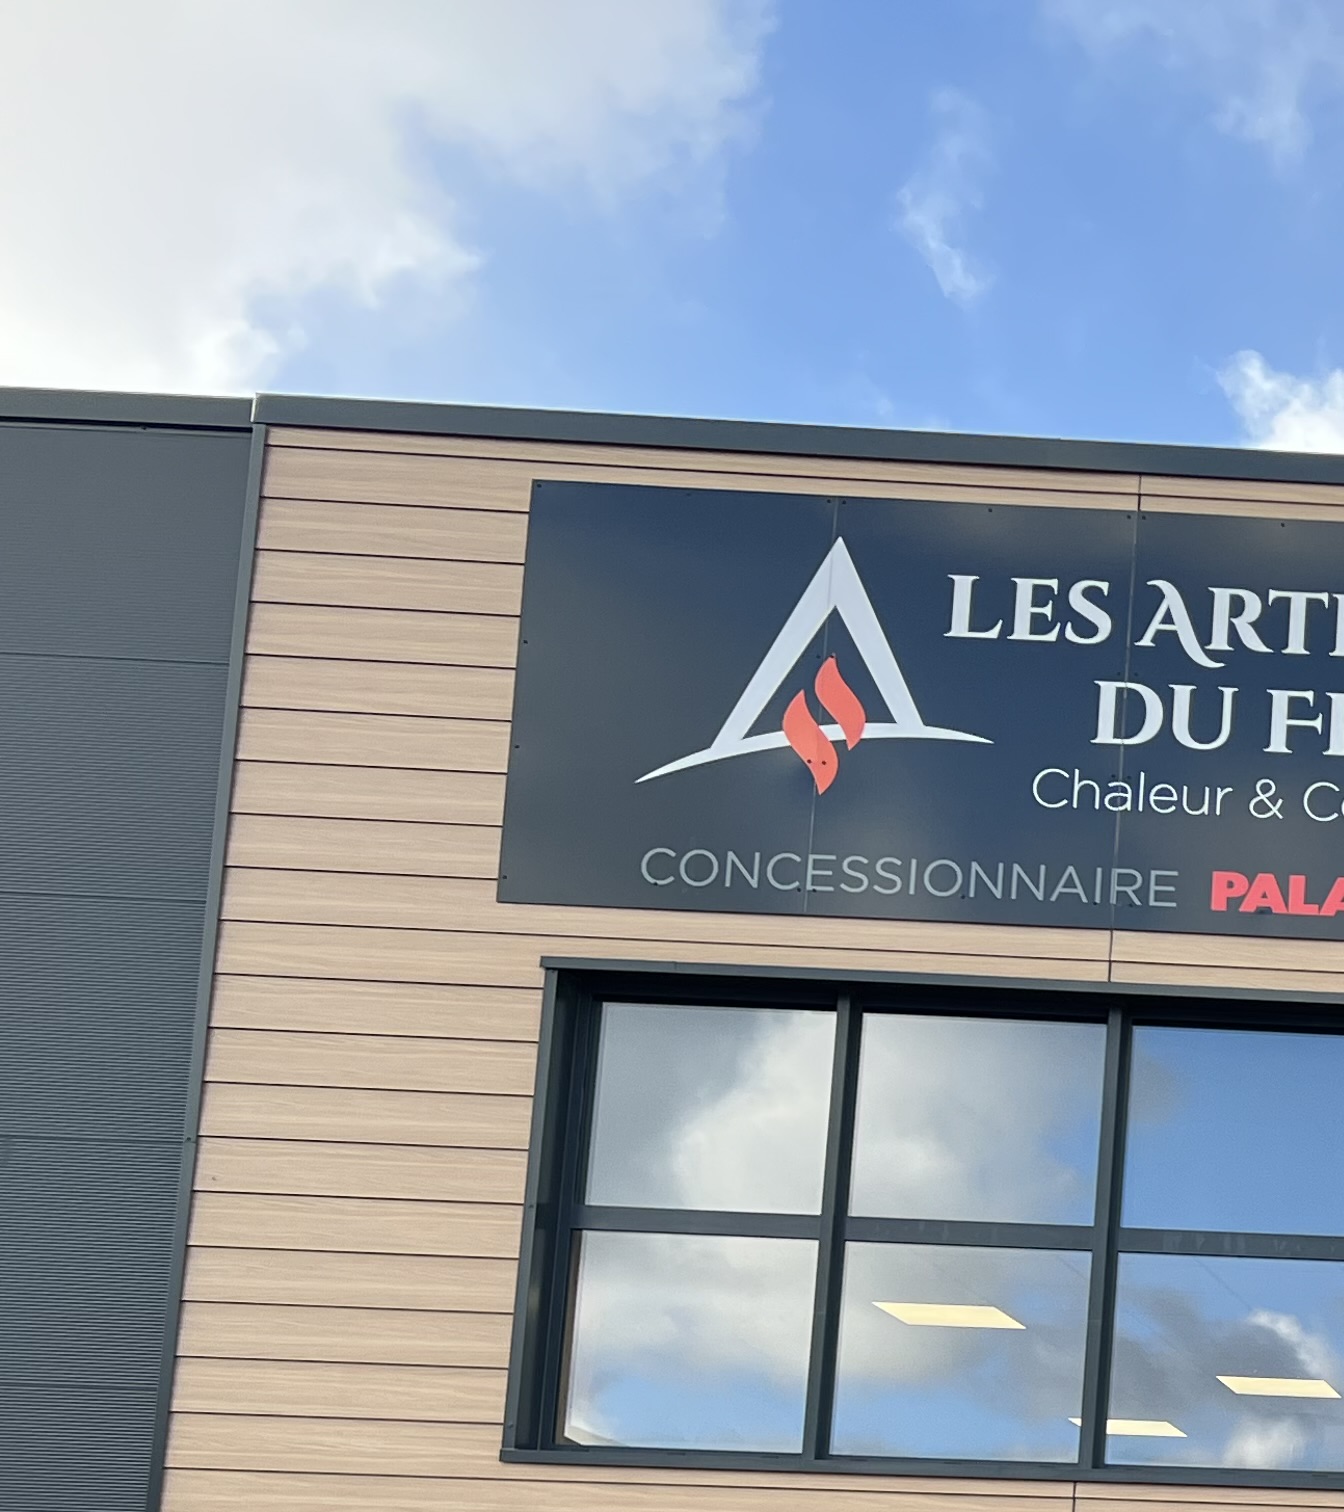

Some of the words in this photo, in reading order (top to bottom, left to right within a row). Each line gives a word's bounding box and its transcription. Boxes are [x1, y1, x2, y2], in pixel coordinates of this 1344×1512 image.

[944, 575, 1111, 644] LES
[1091, 681, 1238, 749] DU
[1033, 769, 1233, 815] Chaleur
[1250, 779, 1283, 819] &
[640, 848, 1178, 908] CONCESSIONNAIRE
